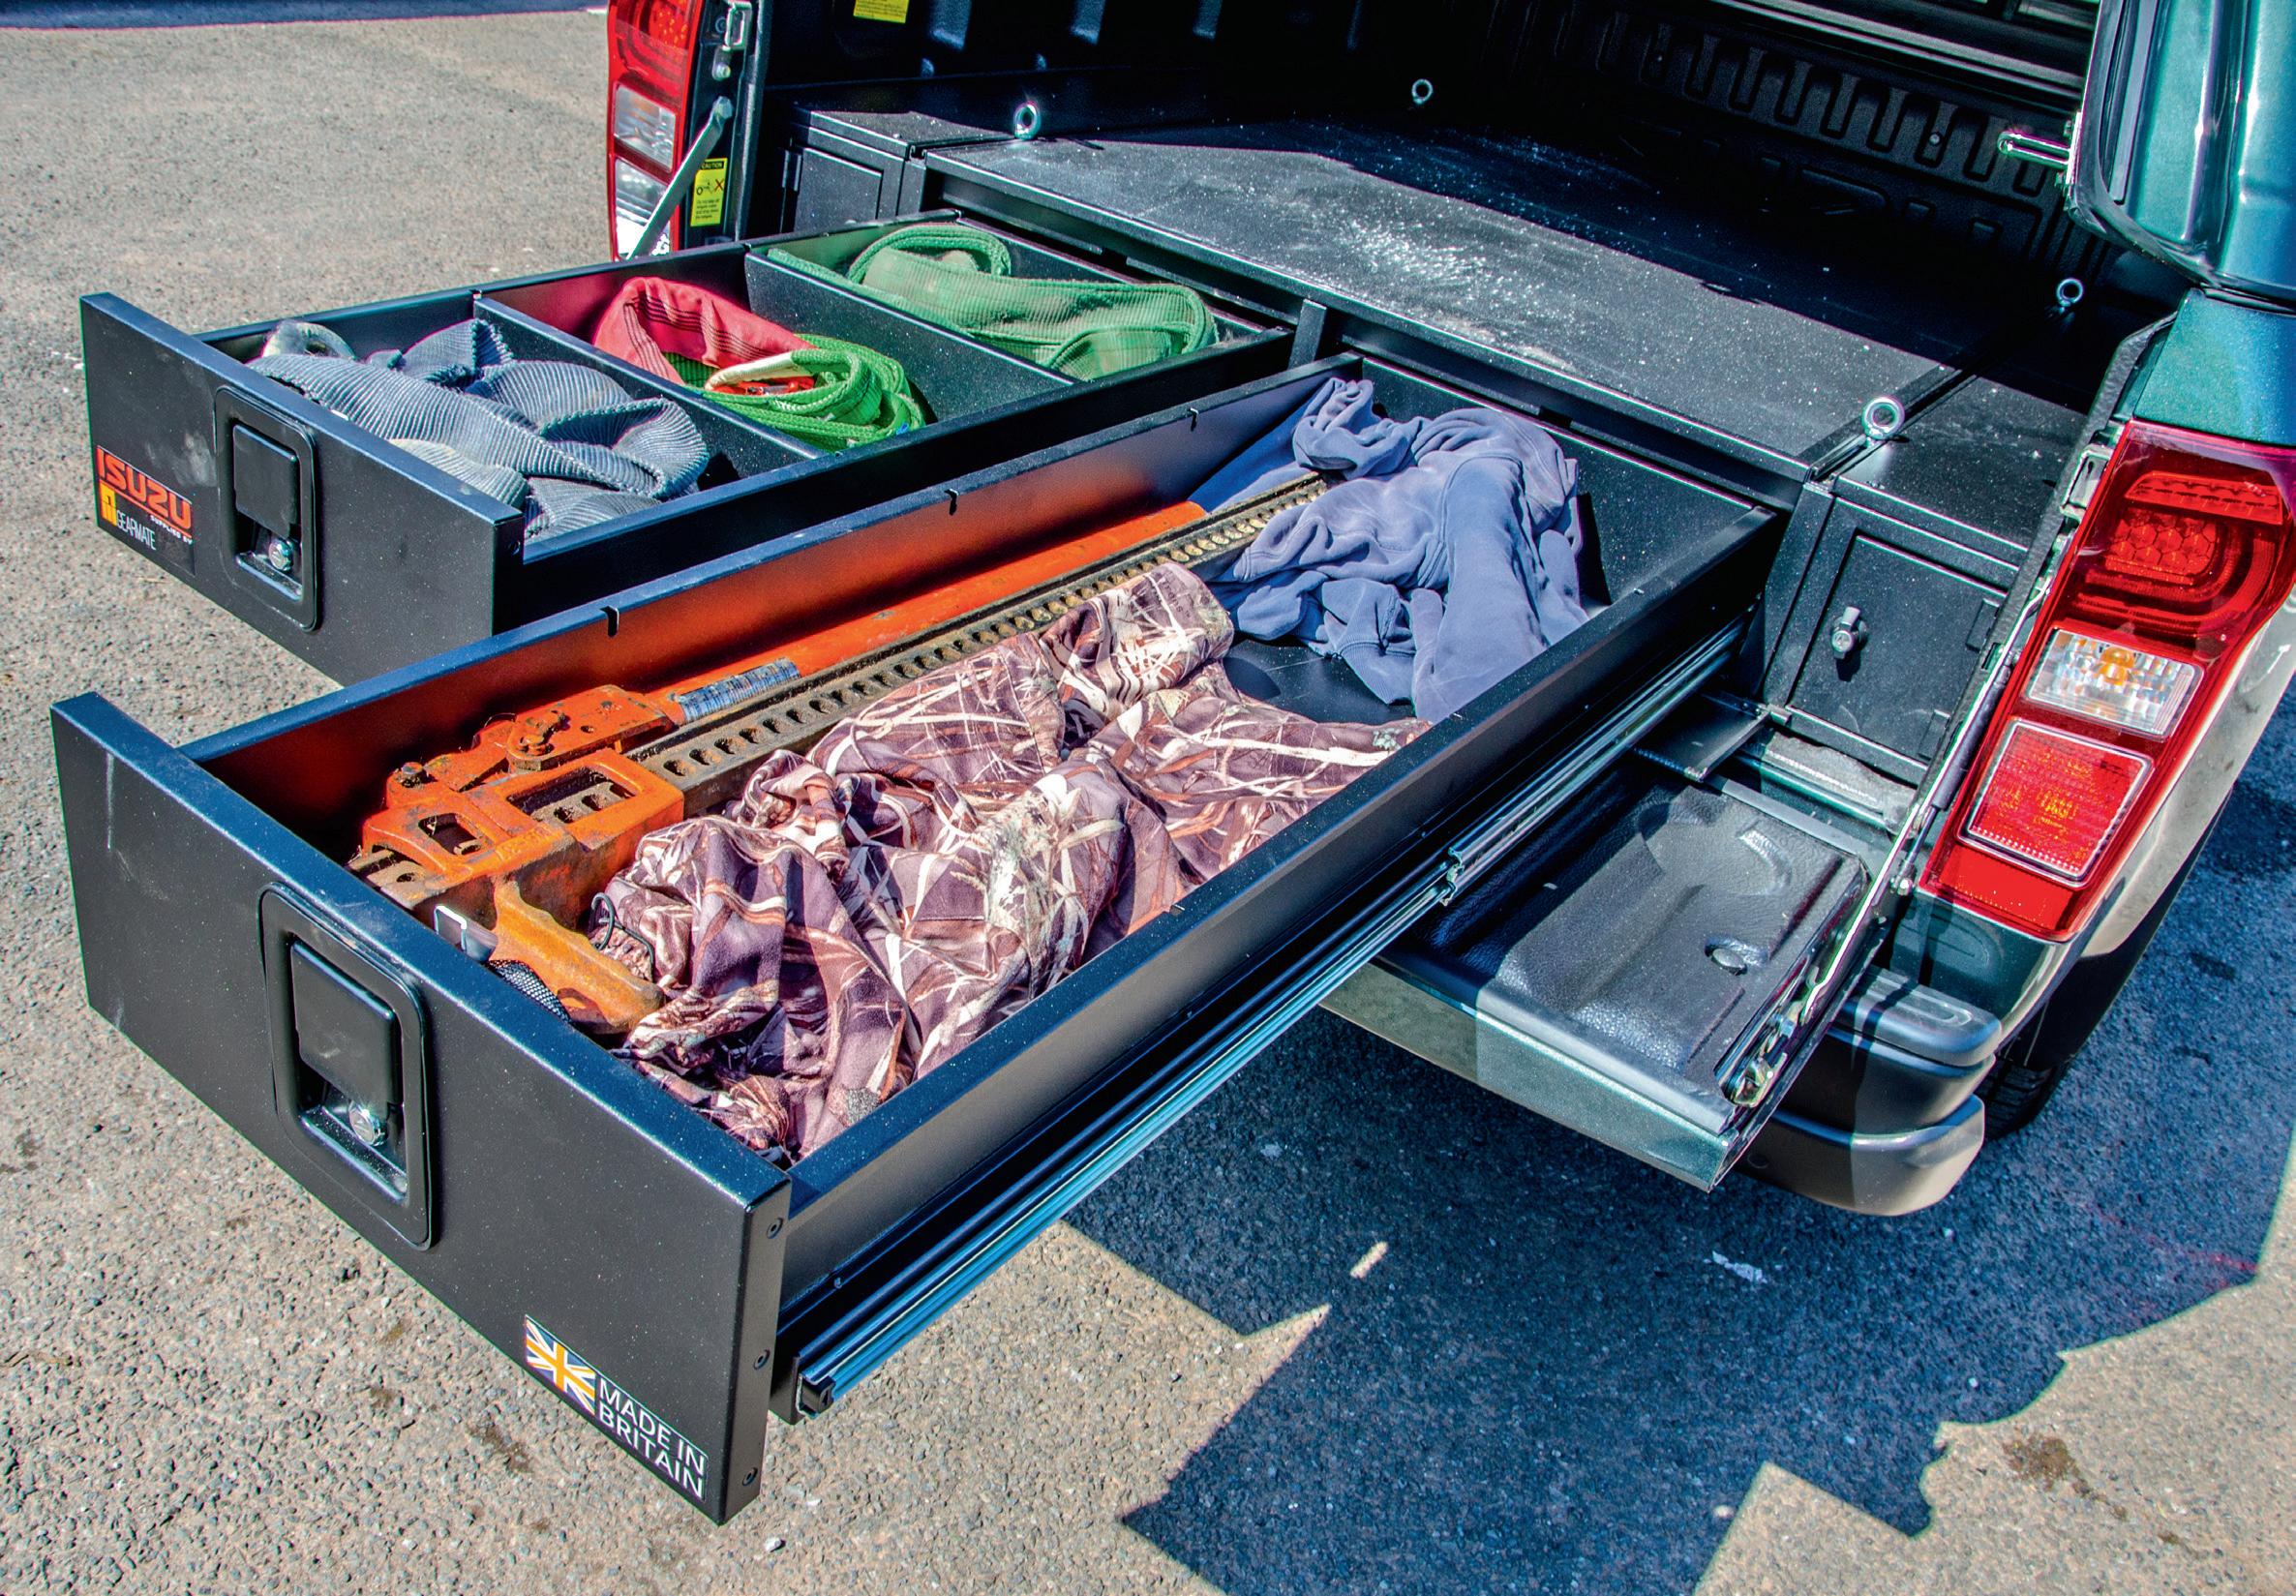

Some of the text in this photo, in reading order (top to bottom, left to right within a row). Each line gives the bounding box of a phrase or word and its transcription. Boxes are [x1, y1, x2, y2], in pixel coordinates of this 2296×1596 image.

[97, 447, 192, 529] ISUZU
[117, 509, 156, 551] GEARMATE
[599, 1400, 704, 1499] BRITAIN
[600, 1377, 704, 1476] MADE IN
